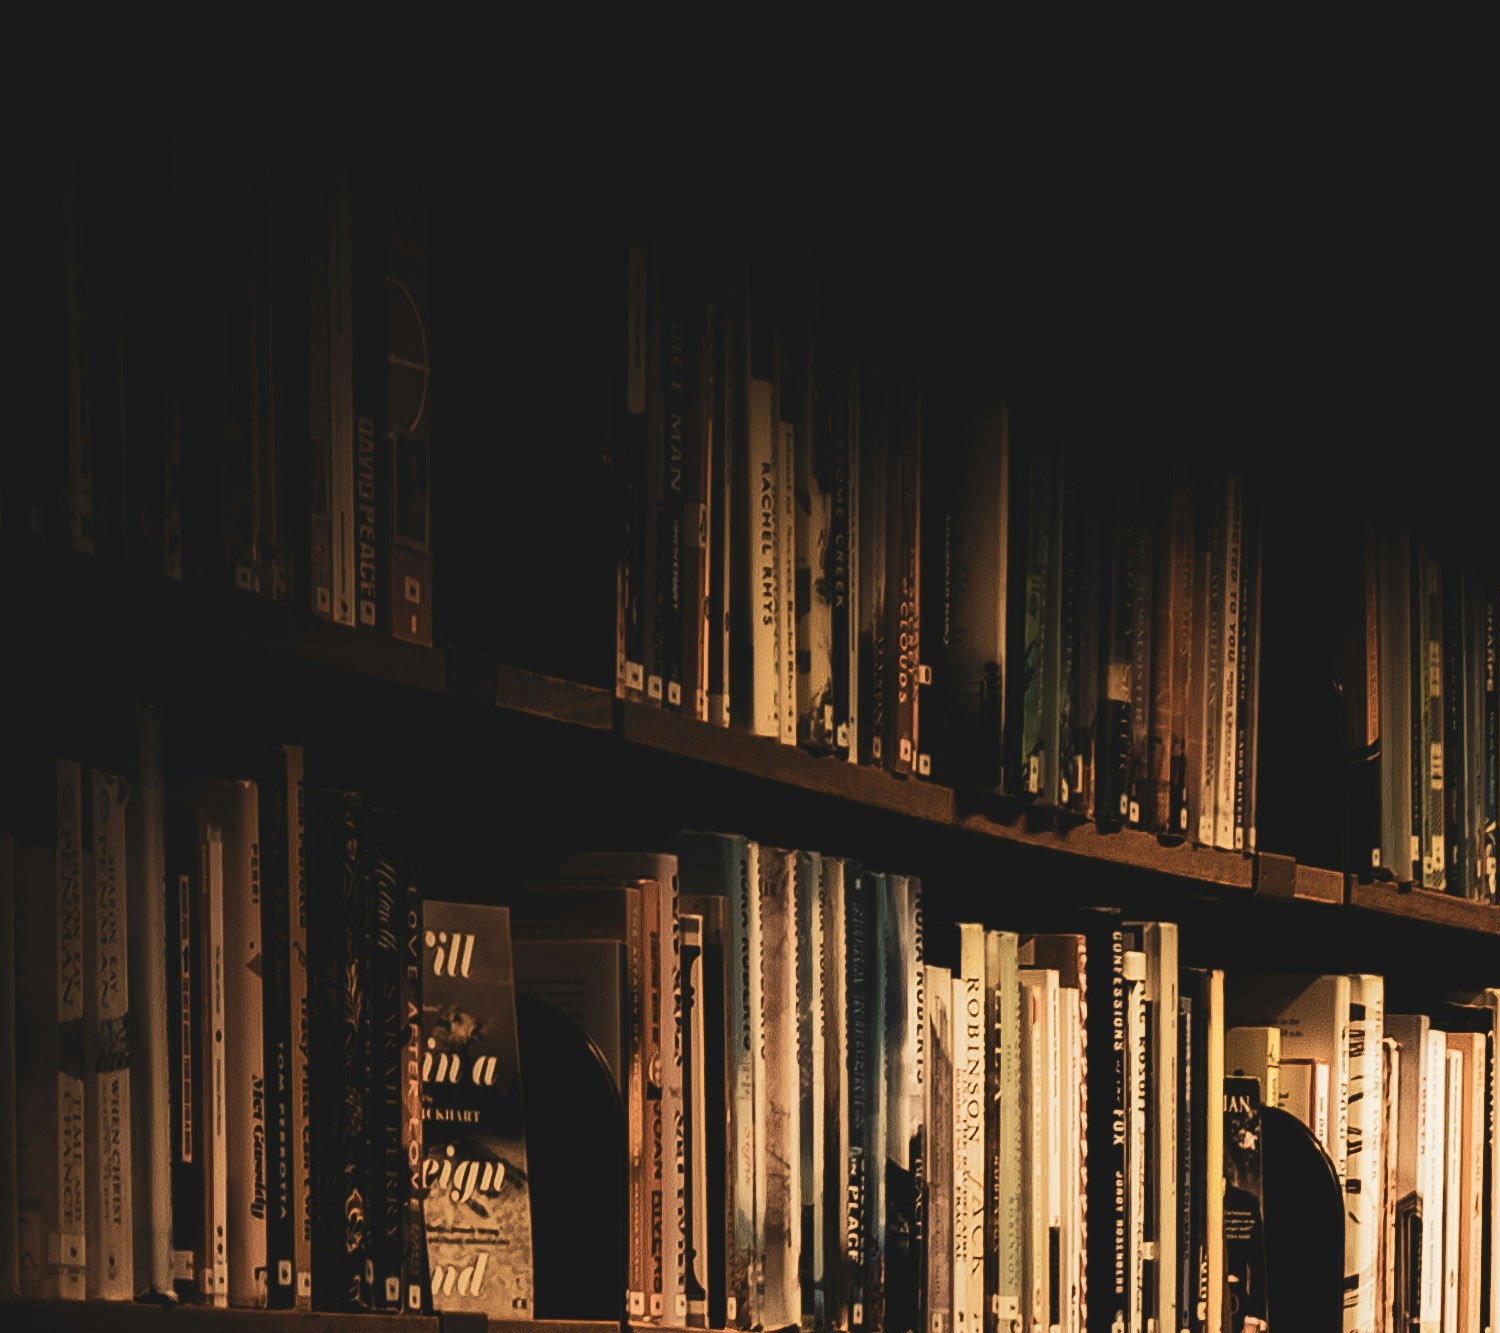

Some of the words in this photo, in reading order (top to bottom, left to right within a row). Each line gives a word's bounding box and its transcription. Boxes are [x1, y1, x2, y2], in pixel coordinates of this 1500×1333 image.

[358, 417, 374, 499] DAVID
[670, 413, 682, 492] MAN
[760, 462, 772, 554] RACHEL
[360, 504, 376, 597] PEACE
[762, 567, 772, 626] RHYS
[1229, 591, 1237, 614] TO
[1228, 622, 1236, 663] YOU
[60, 829, 72, 1007] PENMAN
[71, 849, 80, 939] SHARON
[98, 834, 108, 1009] PENMAN
[108, 855, 118, 942] SHARON
[406, 885, 417, 980] LOVE
[72, 952, 80, 991] KAY
[108, 956, 118, 991] KAY
[424, 928, 476, 978] ill
[277, 1040, 285, 1092] TOM
[382, 982, 398, 1106] SARAH
[407, 1000, 418, 1099] AFTER
[472, 1054, 499, 1087] a
[966, 977, 980, 1142] ROBINSON
[72, 1097, 82, 1168] TIME
[110, 1079, 120, 1145] WHEN
[62, 1090, 72, 1224] CHANCE
[112, 1149, 121, 1226] CHRIST
[384, 1124, 398, 1242] PERRY
[407, 1117, 418, 1212] LOVE
[422, 1143, 507, 1205] eign
[74, 1179, 82, 1221] AND
[848, 1185, 858, 1264] PLACE
[432, 1251, 490, 1298] nd
